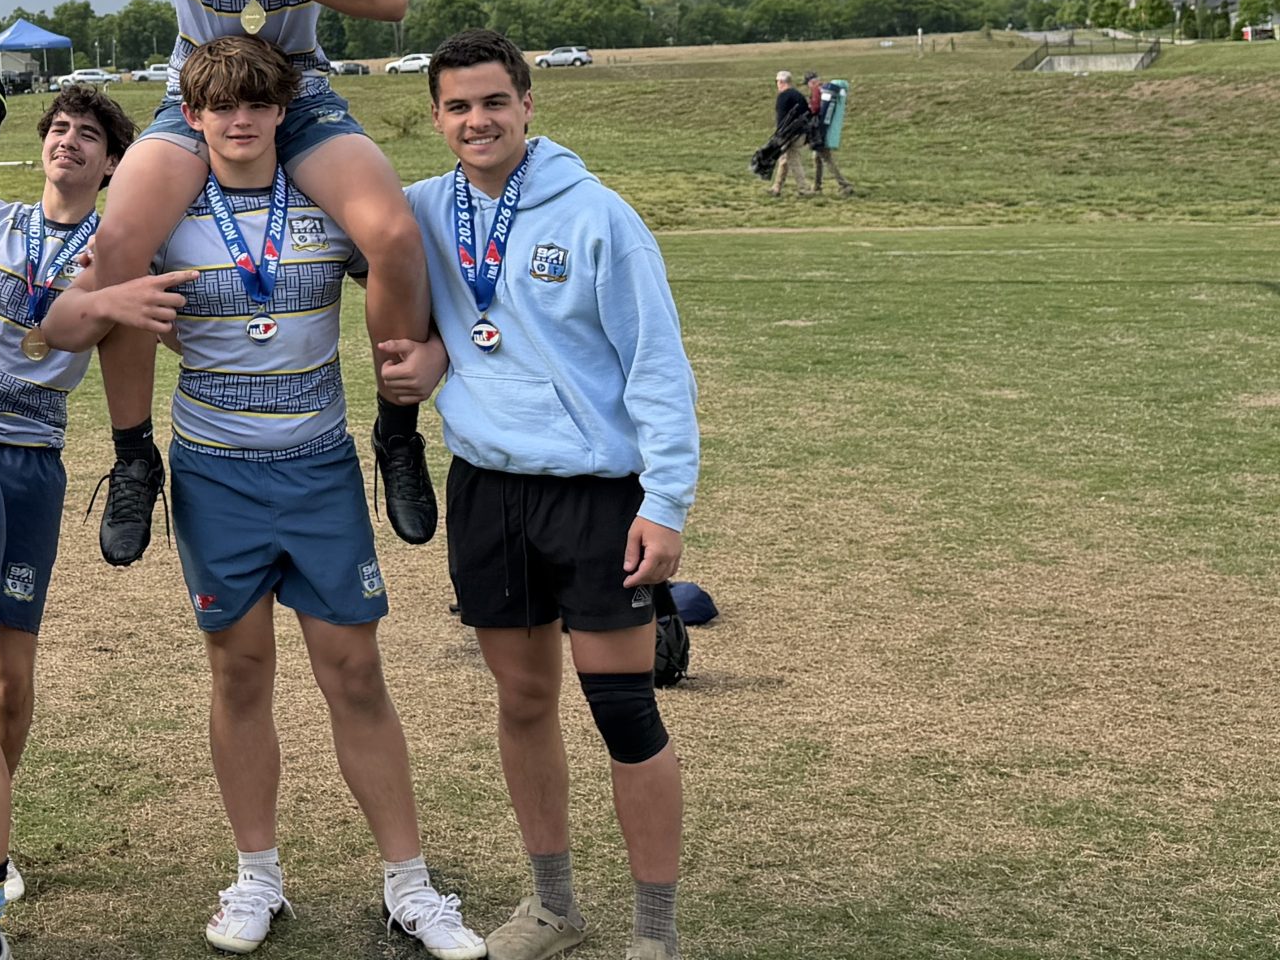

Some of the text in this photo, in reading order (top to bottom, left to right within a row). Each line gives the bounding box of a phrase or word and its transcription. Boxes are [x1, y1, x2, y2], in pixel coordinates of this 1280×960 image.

[205, 181, 238, 240] CHAMPION
[269, 208, 284, 240] 2026
[493, 206, 512, 243] 2026
[54, 222, 92, 266] CHAMPION
[459, 212, 471, 245] 2026
[29, 238, 41, 265] 2026
